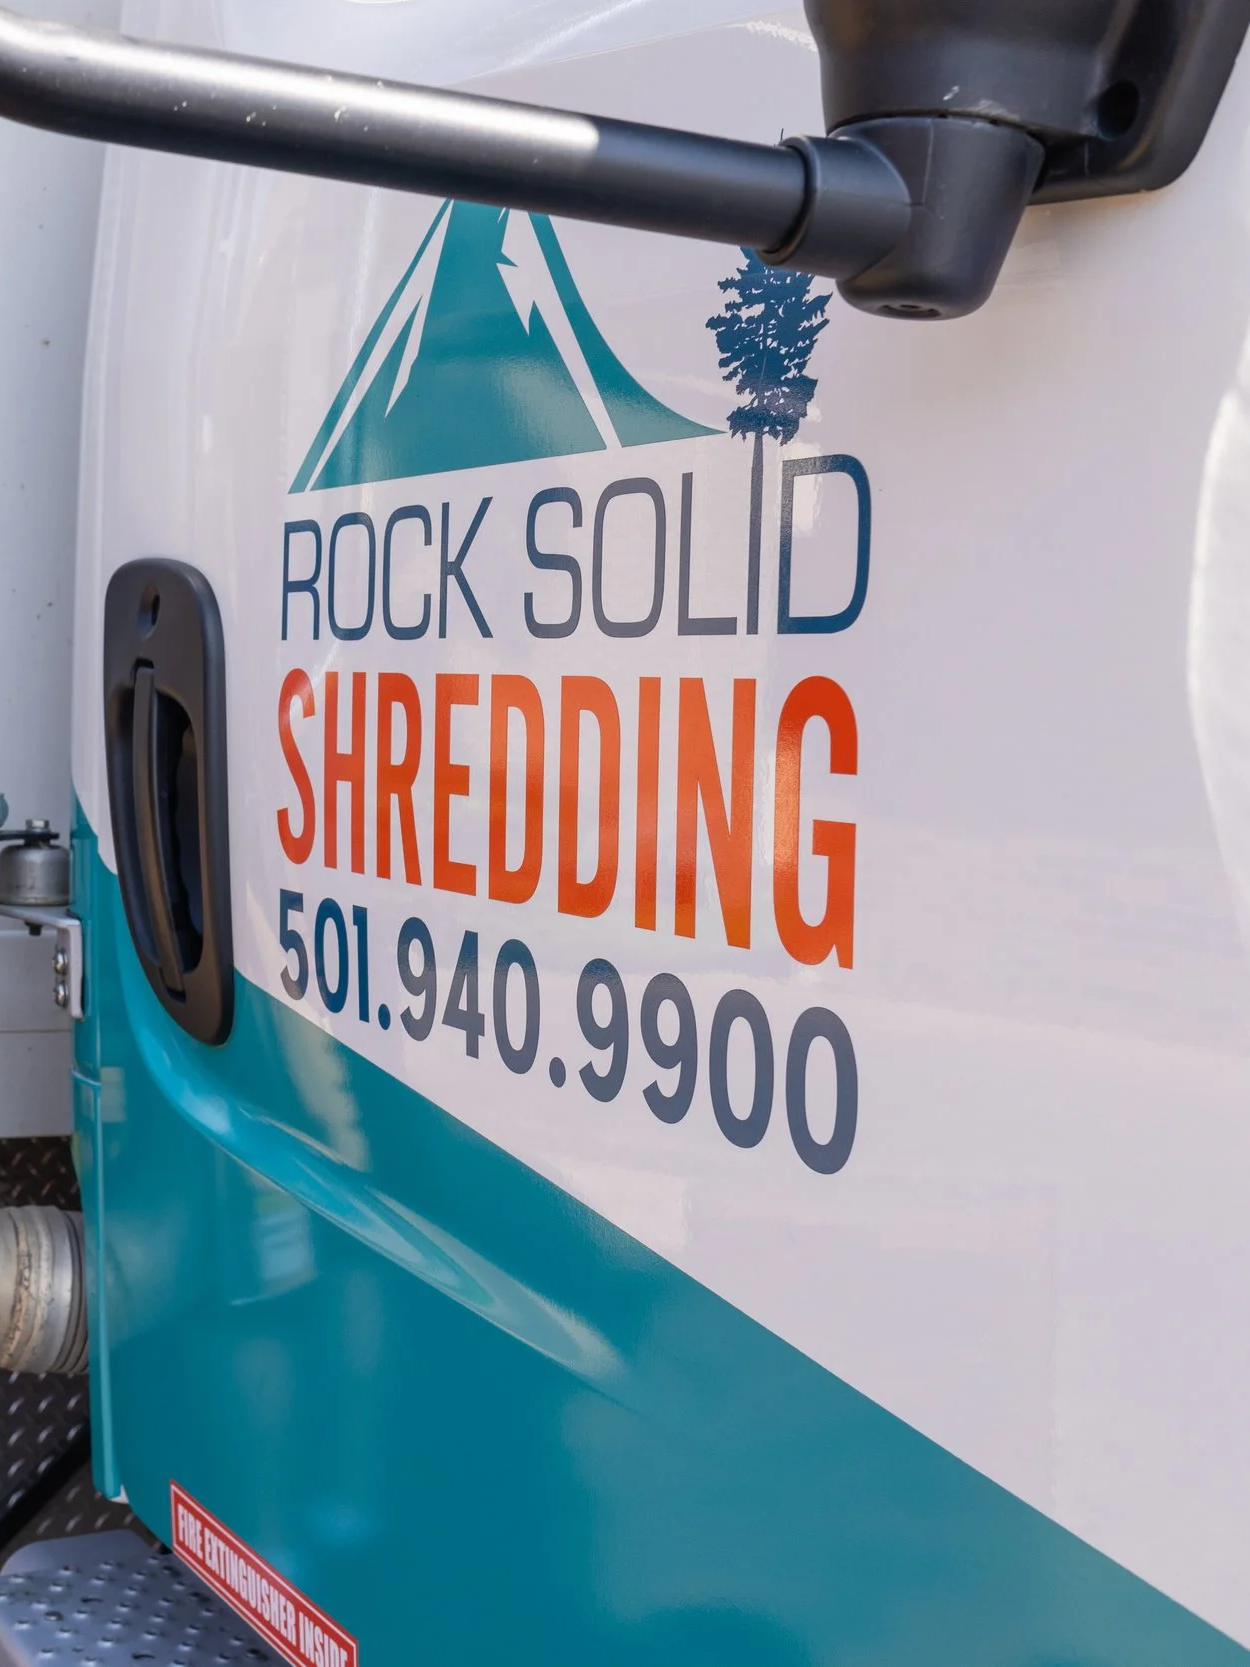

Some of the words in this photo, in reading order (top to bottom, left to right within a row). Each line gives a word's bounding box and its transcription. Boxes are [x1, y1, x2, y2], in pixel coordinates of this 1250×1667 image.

[281, 497, 493, 641] ROCK
[524, 452, 872, 639] SOLID
[276, 668, 858, 970] SHREDDING
[279, 888, 858, 1175] 501.940.9900
[177, 1503, 203, 1560] FIRE
[203, 1526, 296, 1647] EXTINGUISHER
